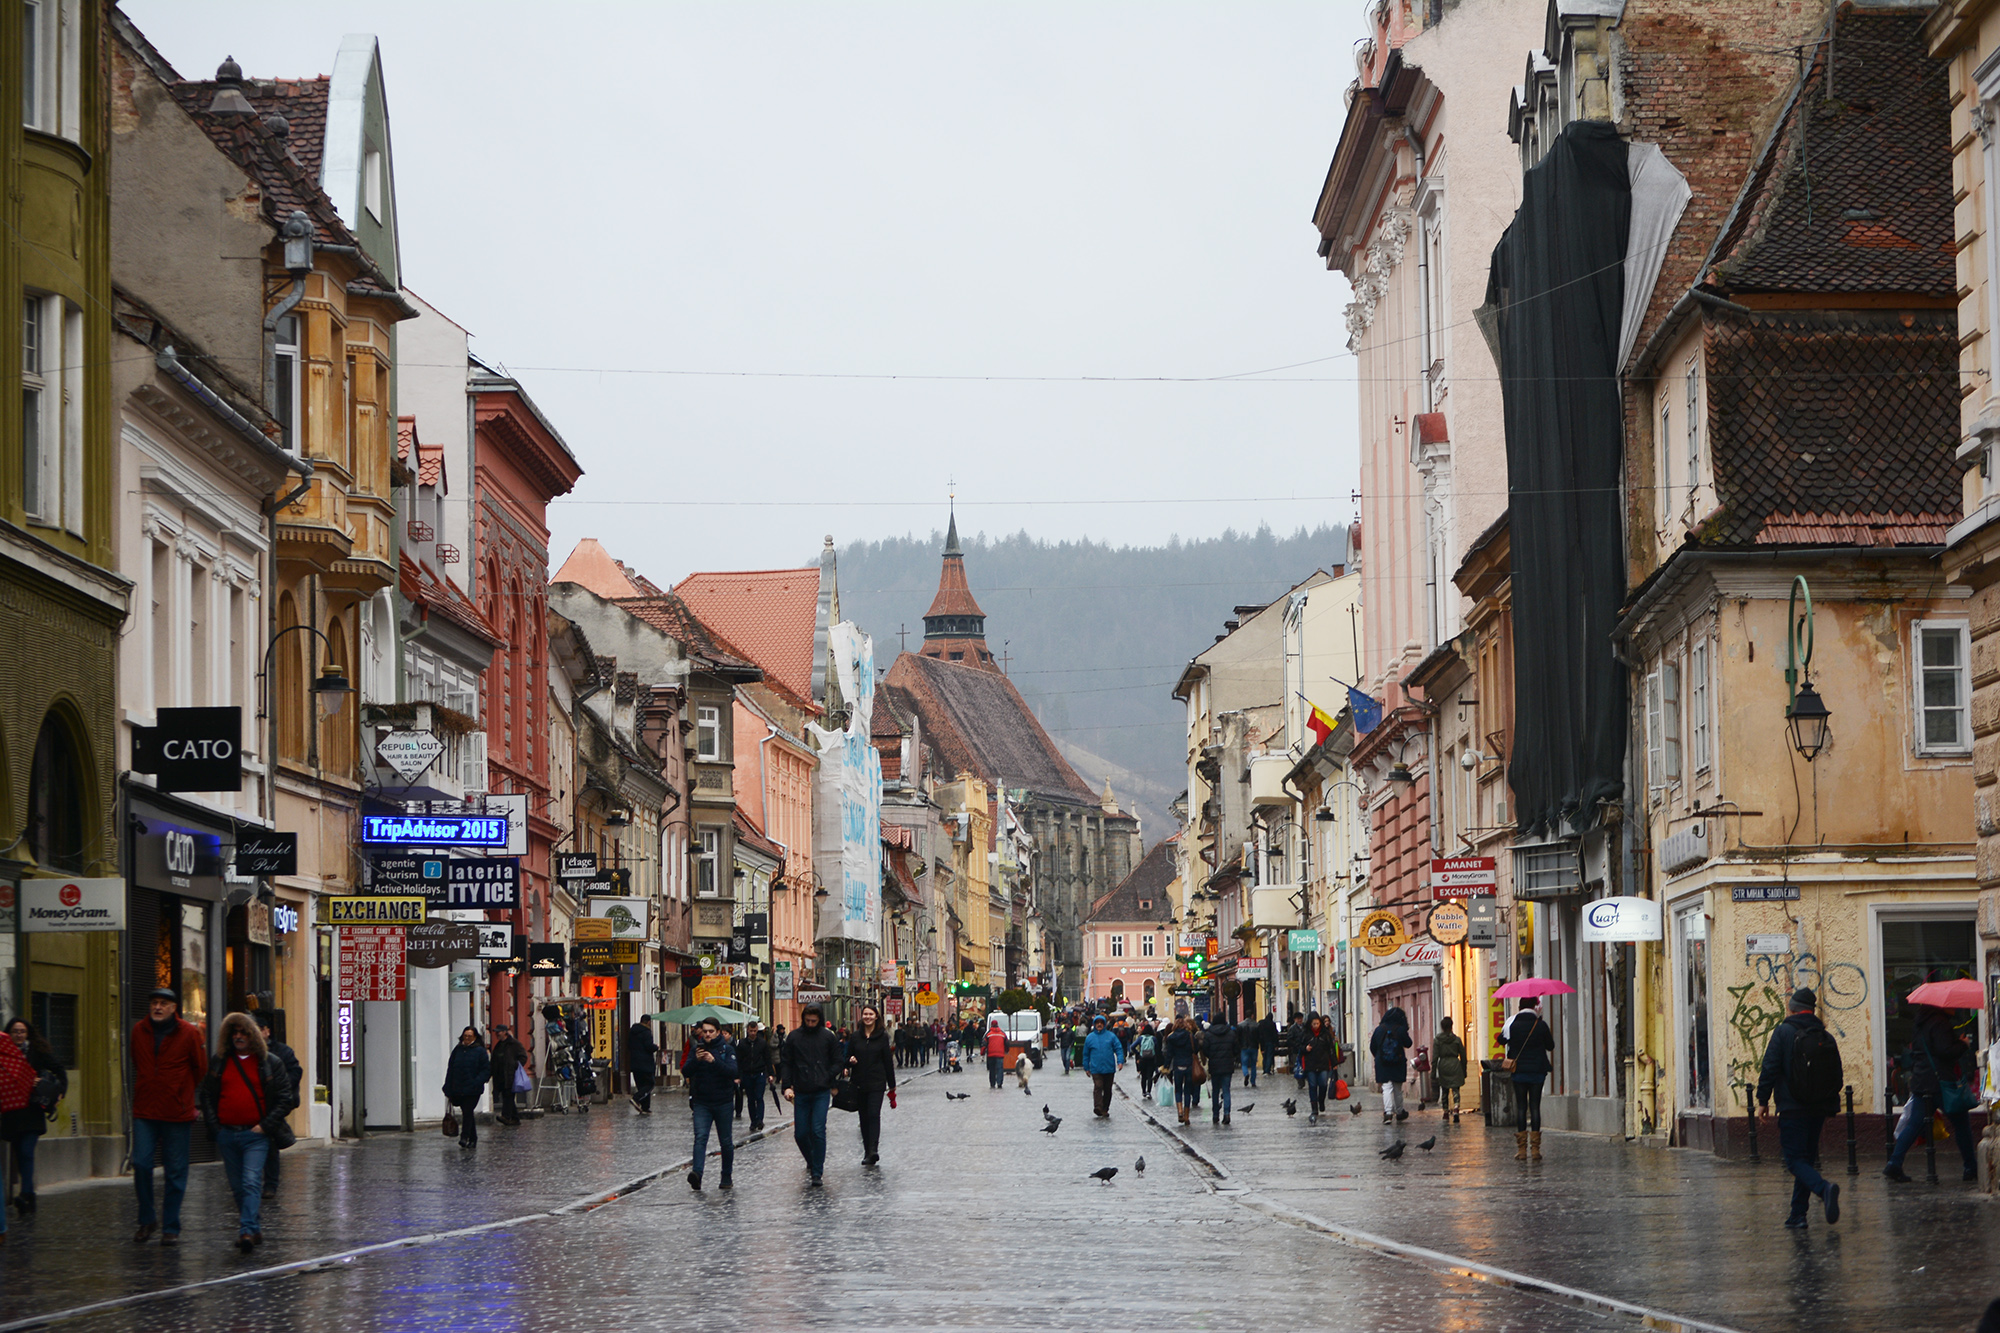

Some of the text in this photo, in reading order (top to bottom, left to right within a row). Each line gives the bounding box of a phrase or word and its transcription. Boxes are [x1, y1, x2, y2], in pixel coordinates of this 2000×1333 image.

[163, 739, 233, 760] CATO
[370, 818, 499, 842] TripAdvisor 2015
[166, 830, 195, 875] CATO
[239, 839, 292, 856] Amulet
[251, 858, 280, 872] Pub
[381, 859, 416, 869] agentie
[1444, 861, 1482, 870] AMANET
[386, 870, 419, 879] turism
[448, 864, 513, 880] lateria
[1452, 872, 1488, 880] MoneyGram
[374, 884, 402, 894] Active
[403, 883, 440, 896] Holidays
[484, 882, 514, 903] ICE
[1439, 886, 1490, 896] EXCHANGE
[1734, 889, 1745, 898] STR
[1746, 889, 1765, 898] MIHAIL
[28, 906, 109, 920] MoneyGram
[332, 901, 421, 920] EXCHANGE
[1589, 903, 1620, 928] Cuart
[351, 927, 374, 935] EXCHANGE
[1437, 922, 1462, 930] Waffle
[406, 939, 438, 950] REET
[441, 939, 473, 949] CAFE
[1367, 937, 1394, 945] LUCA
[342, 951, 401, 963] EUR 4.655 4.685
[342, 964, 397, 976] USD 3.73 3.82
[342, 976, 396, 988] GBP 5.20 5.28
[342, 988, 396, 1000] CHF 3.94 4.04
[338, 1007, 351, 1061] HOSTEL
